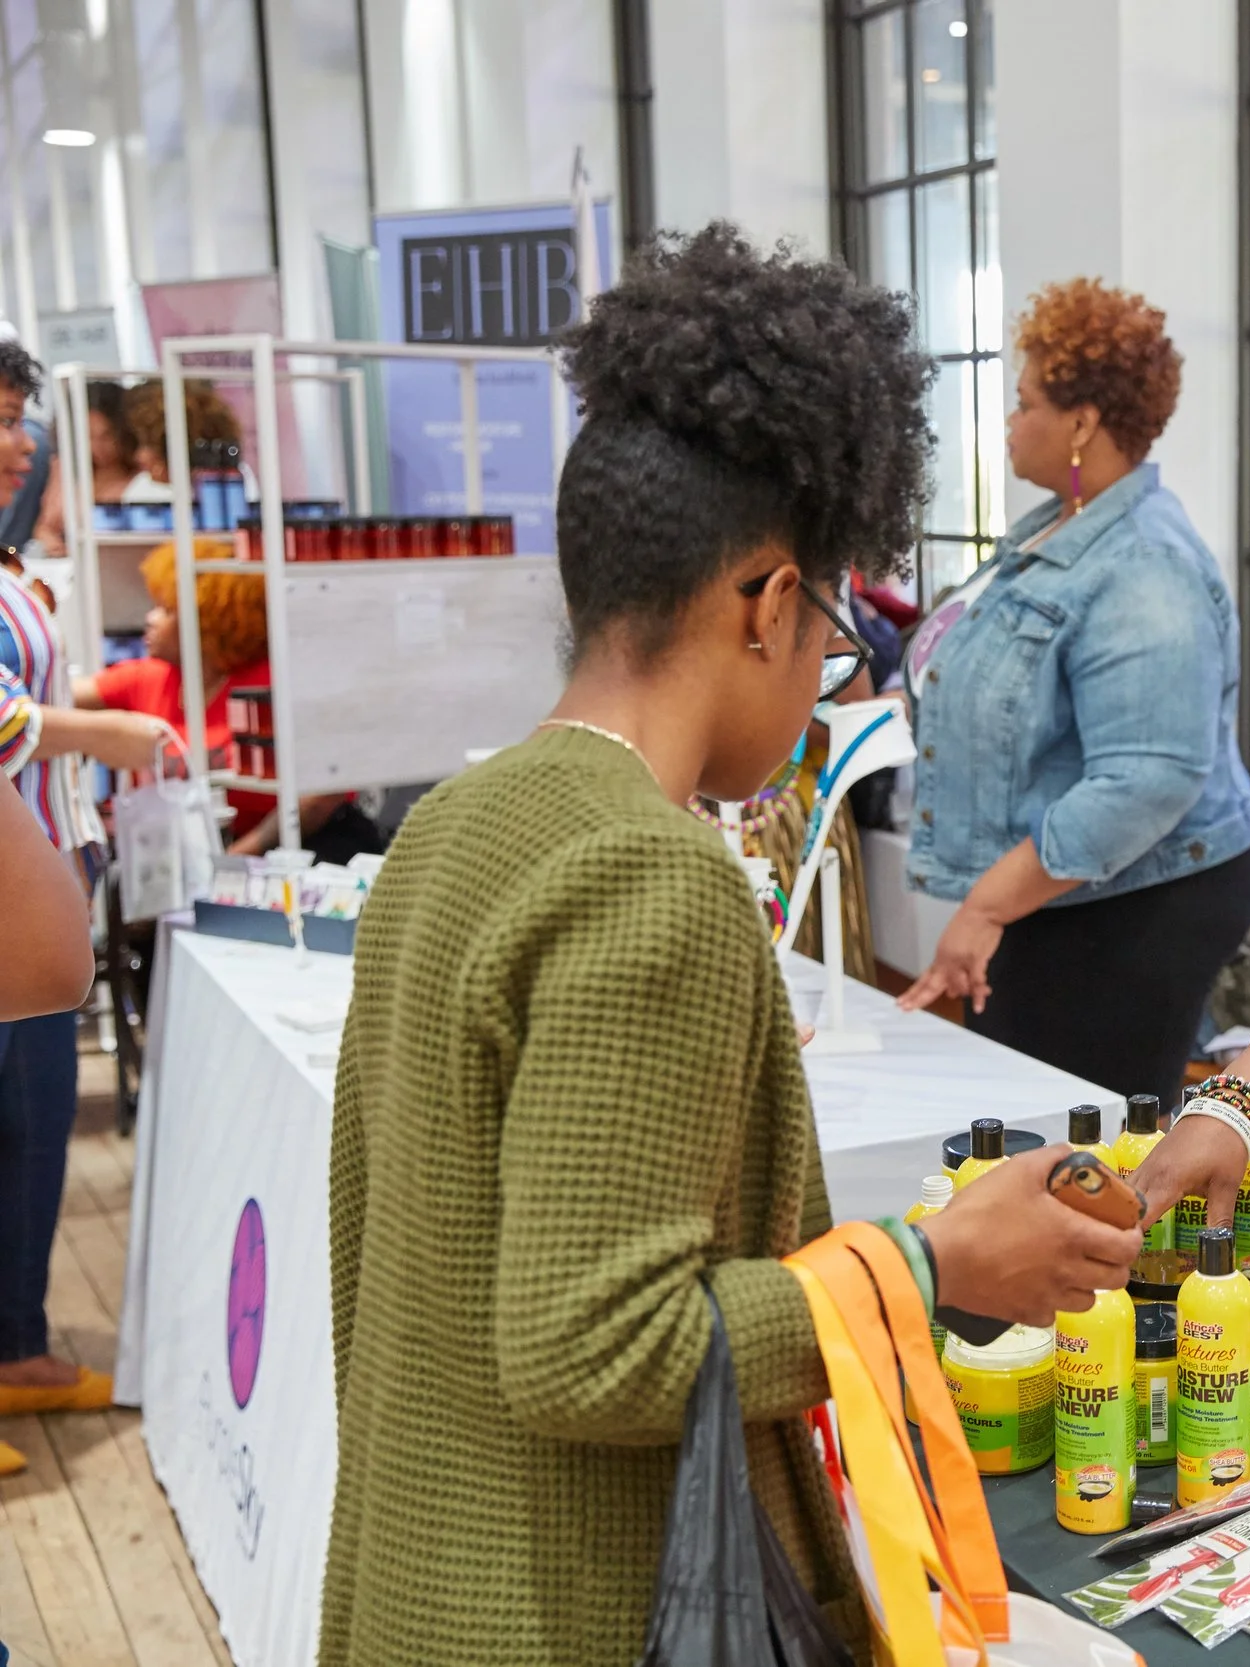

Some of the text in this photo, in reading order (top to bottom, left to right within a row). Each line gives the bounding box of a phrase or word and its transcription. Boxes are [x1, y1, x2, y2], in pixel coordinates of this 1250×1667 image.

[1183, 1328, 1223, 1340] BEST
[1184, 1319, 1223, 1334] Africa's
[1177, 1335, 1237, 1361] Textures
[1200, 1362, 1229, 1373] Butter
[1068, 1375, 1095, 1386] Butter
[1177, 1364, 1249, 1388] OISTURE
[1057, 1382, 1119, 1402] STURE
[1056, 1397, 1101, 1418] ENEW
[967, 1417, 1003, 1428] CURLS
